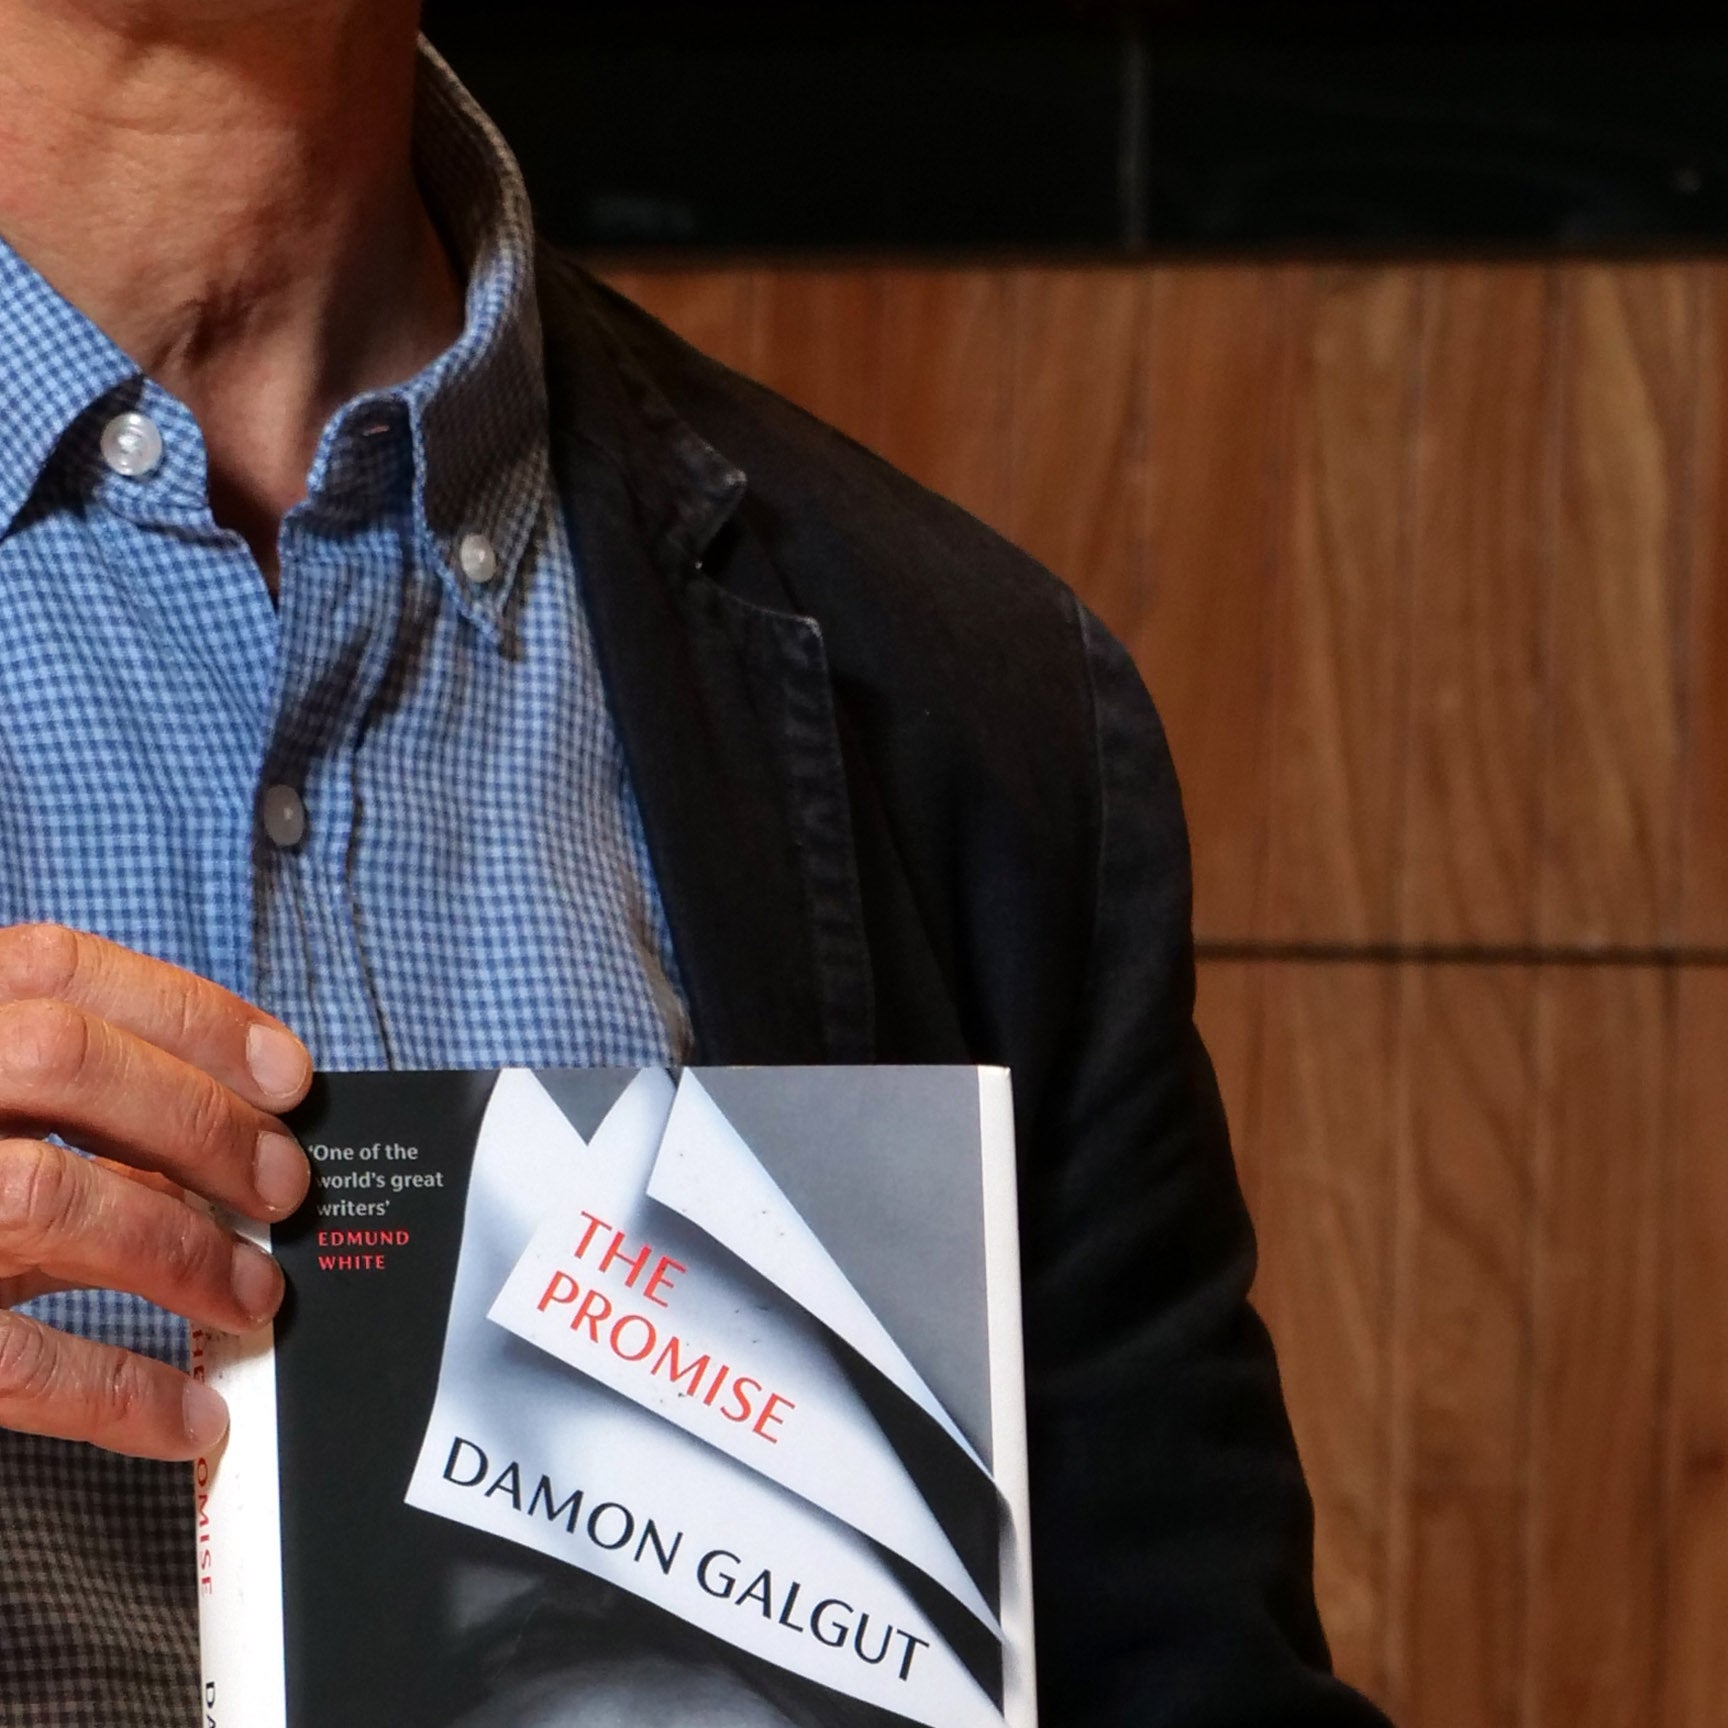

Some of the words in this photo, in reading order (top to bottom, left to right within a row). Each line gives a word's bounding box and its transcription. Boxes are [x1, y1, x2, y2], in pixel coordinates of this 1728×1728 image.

[359, 1143, 380, 1161] of
[385, 1143, 419, 1161] the
[317, 1172, 386, 1189] world’s
[391, 1172, 444, 1192] great
[317, 1200, 390, 1217] writers’
[318, 1230, 410, 1247] EDMUND
[318, 1254, 386, 1271] WHITE
[574, 1210, 687, 1308] THE
[536, 1270, 796, 1444] PROMISE
[195, 1458, 213, 1595] OMISE
[442, 1436, 683, 1575] DAMON
[696, 1549, 930, 1681] GALGUT
